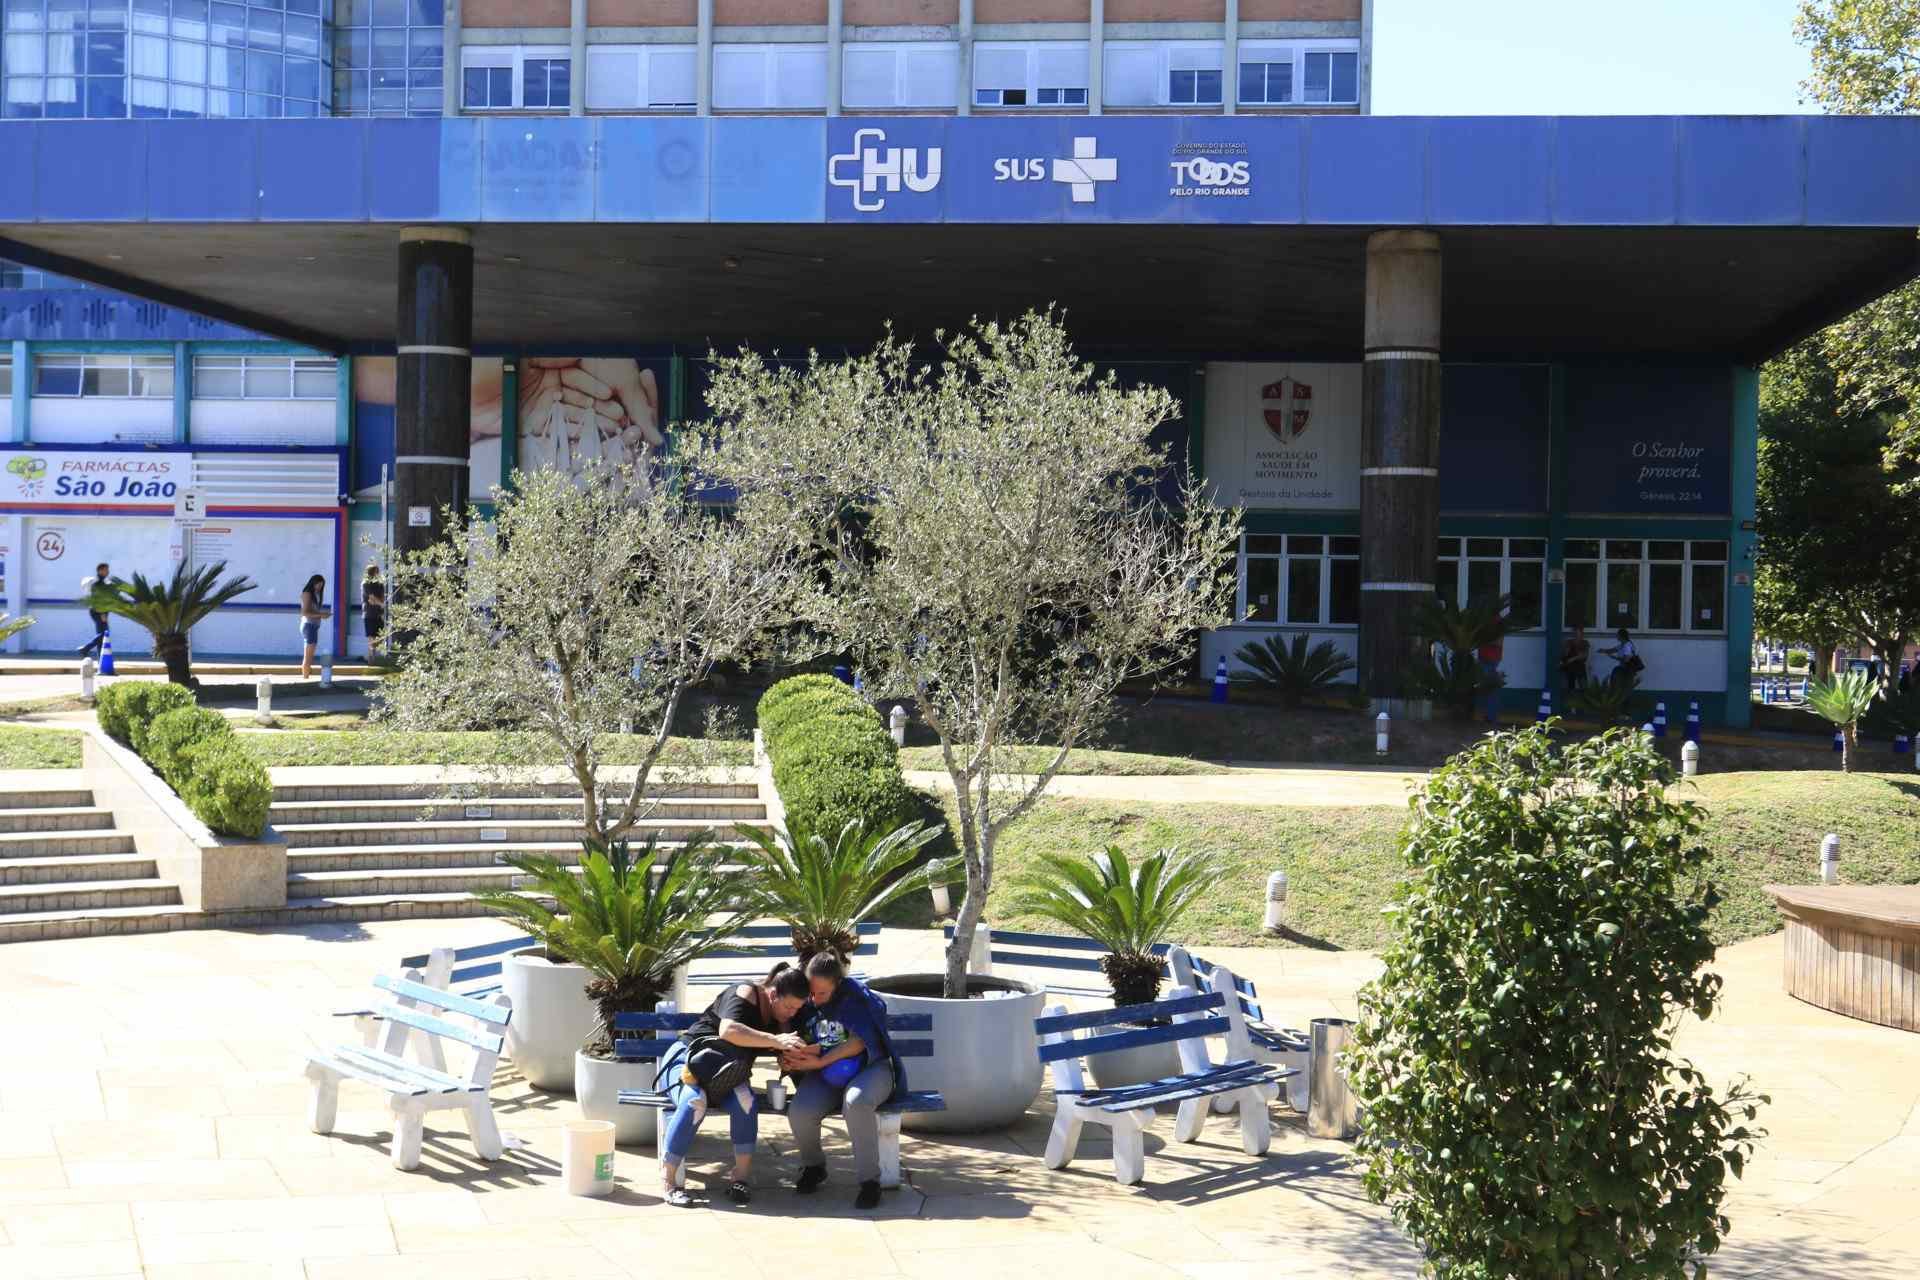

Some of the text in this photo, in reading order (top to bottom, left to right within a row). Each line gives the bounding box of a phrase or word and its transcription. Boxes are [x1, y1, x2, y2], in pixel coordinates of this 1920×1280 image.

[994, 158, 1046, 181] SUS
[1170, 157, 1250, 186] TODOS
[1169, 188, 1250, 196] PELO RIO GRANDE
[1255, 449, 1318, 461] ASSOCIAÇÃO
[1632, 440, 1704, 458] O Senhor
[62, 457, 170, 473] FARMÁCIAS
[1255, 471, 1318, 479] MOVIMENTO
[54, 474, 177, 498] São João
[42, 539, 60, 552] 24
